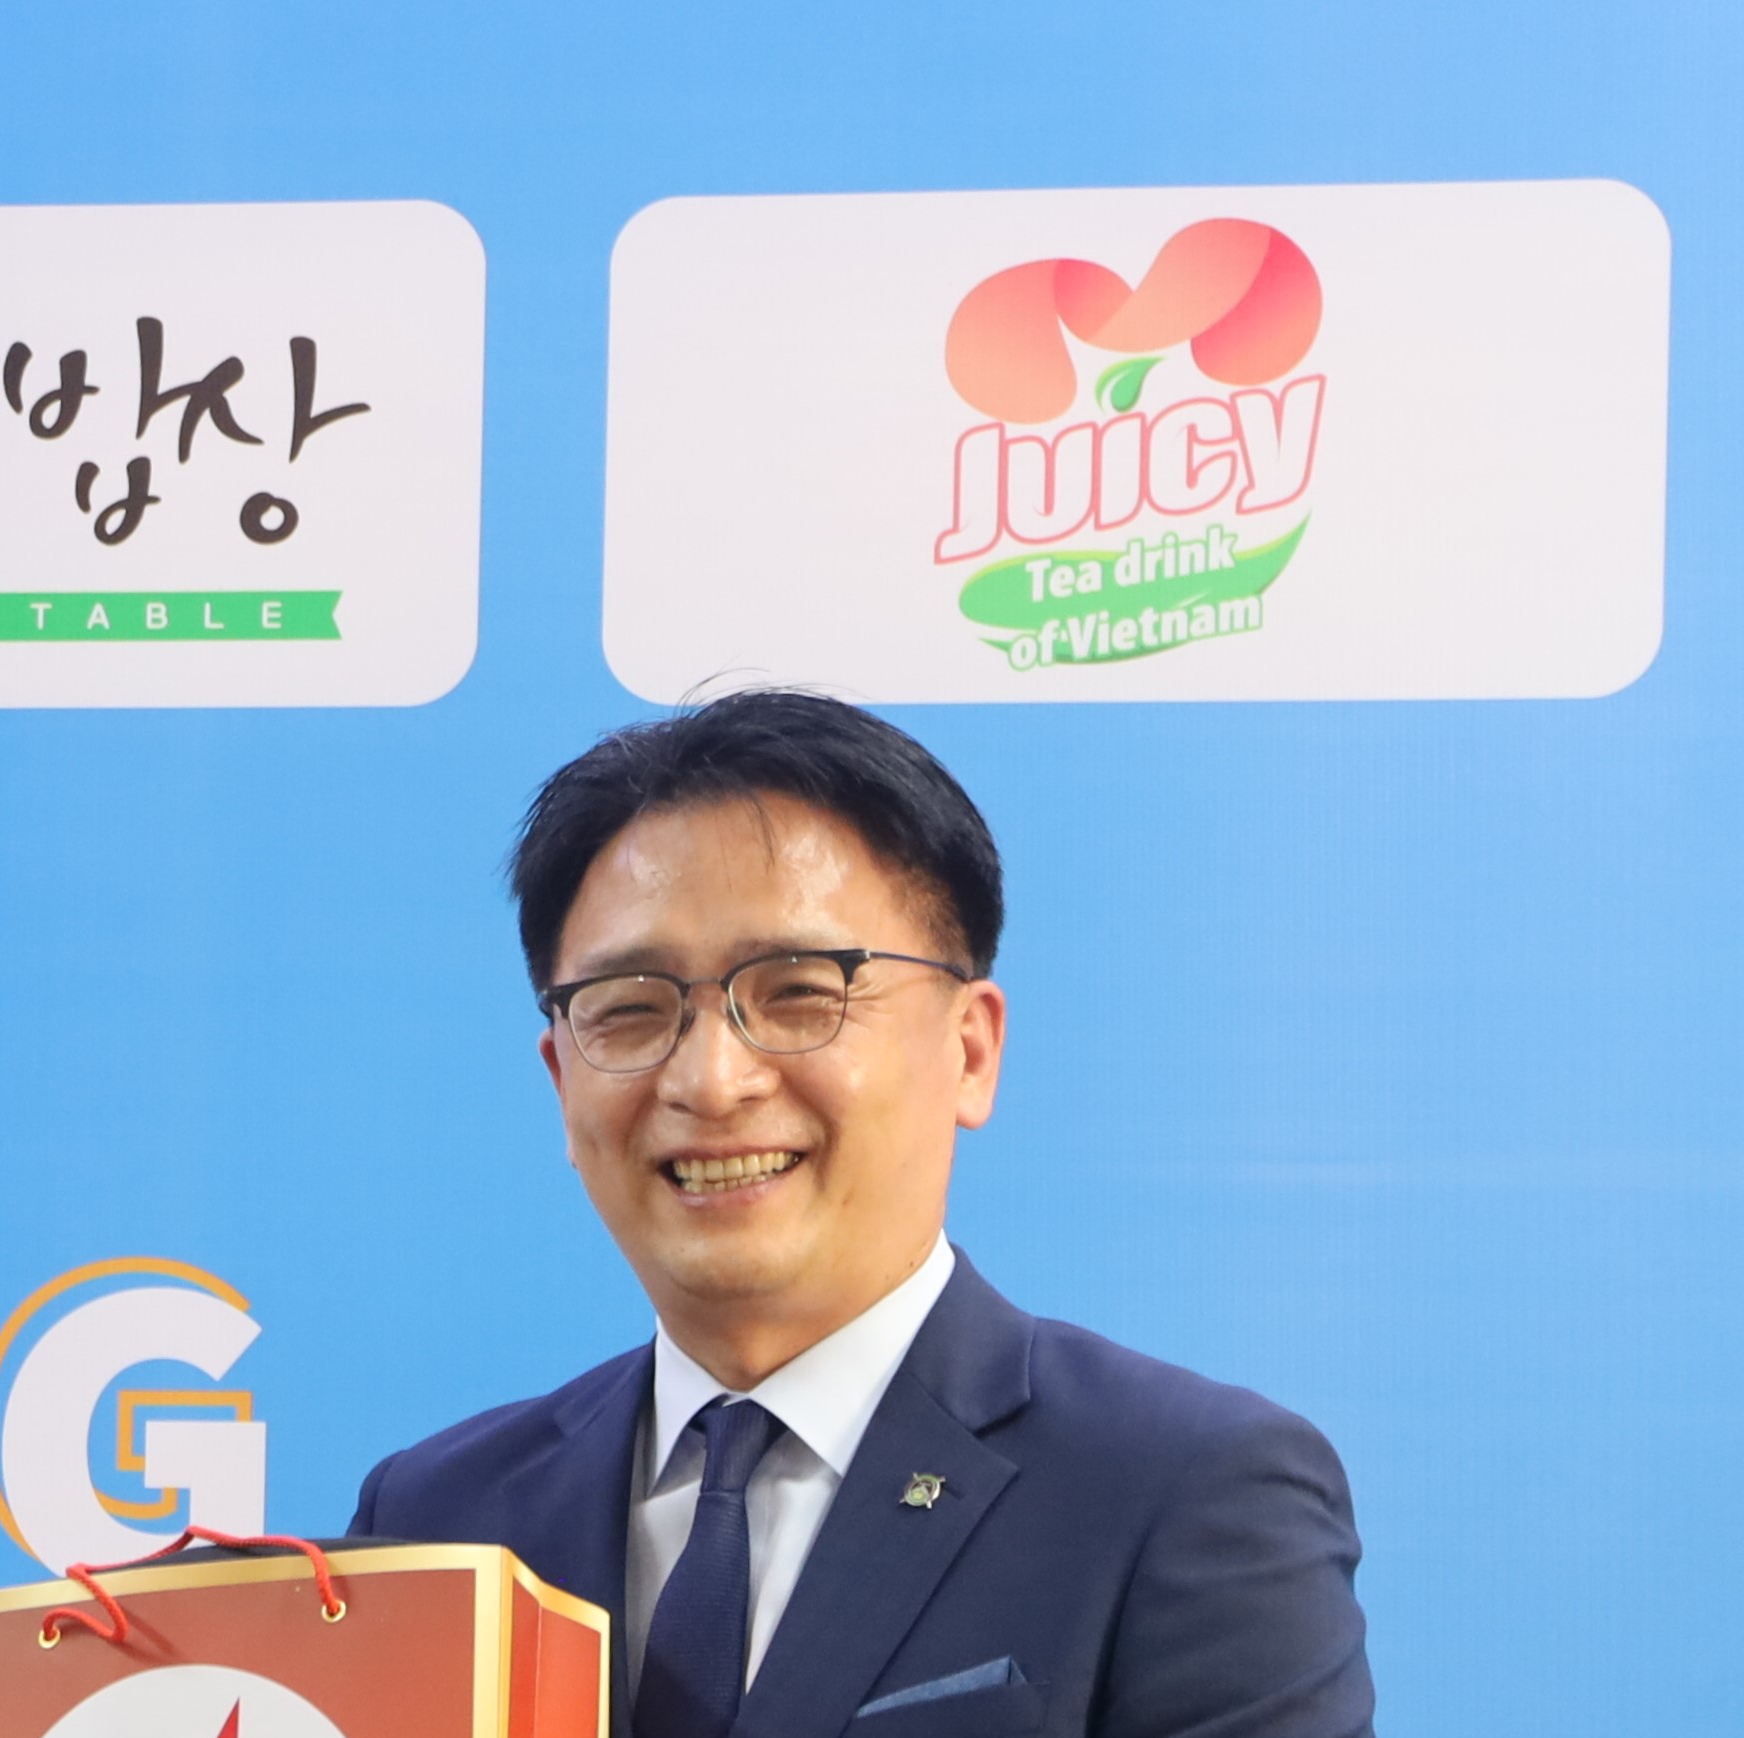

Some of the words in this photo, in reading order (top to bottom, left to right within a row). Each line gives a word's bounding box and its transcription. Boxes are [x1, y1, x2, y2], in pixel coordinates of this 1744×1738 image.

[2, 316, 372, 546] 밥상
[1023, 557, 1104, 603] Tea
[1113, 524, 1239, 587] drink
[29, 601, 283, 630] TABLE
[1008, 618, 1061, 672] of
[1066, 594, 1263, 662] Vietnam
